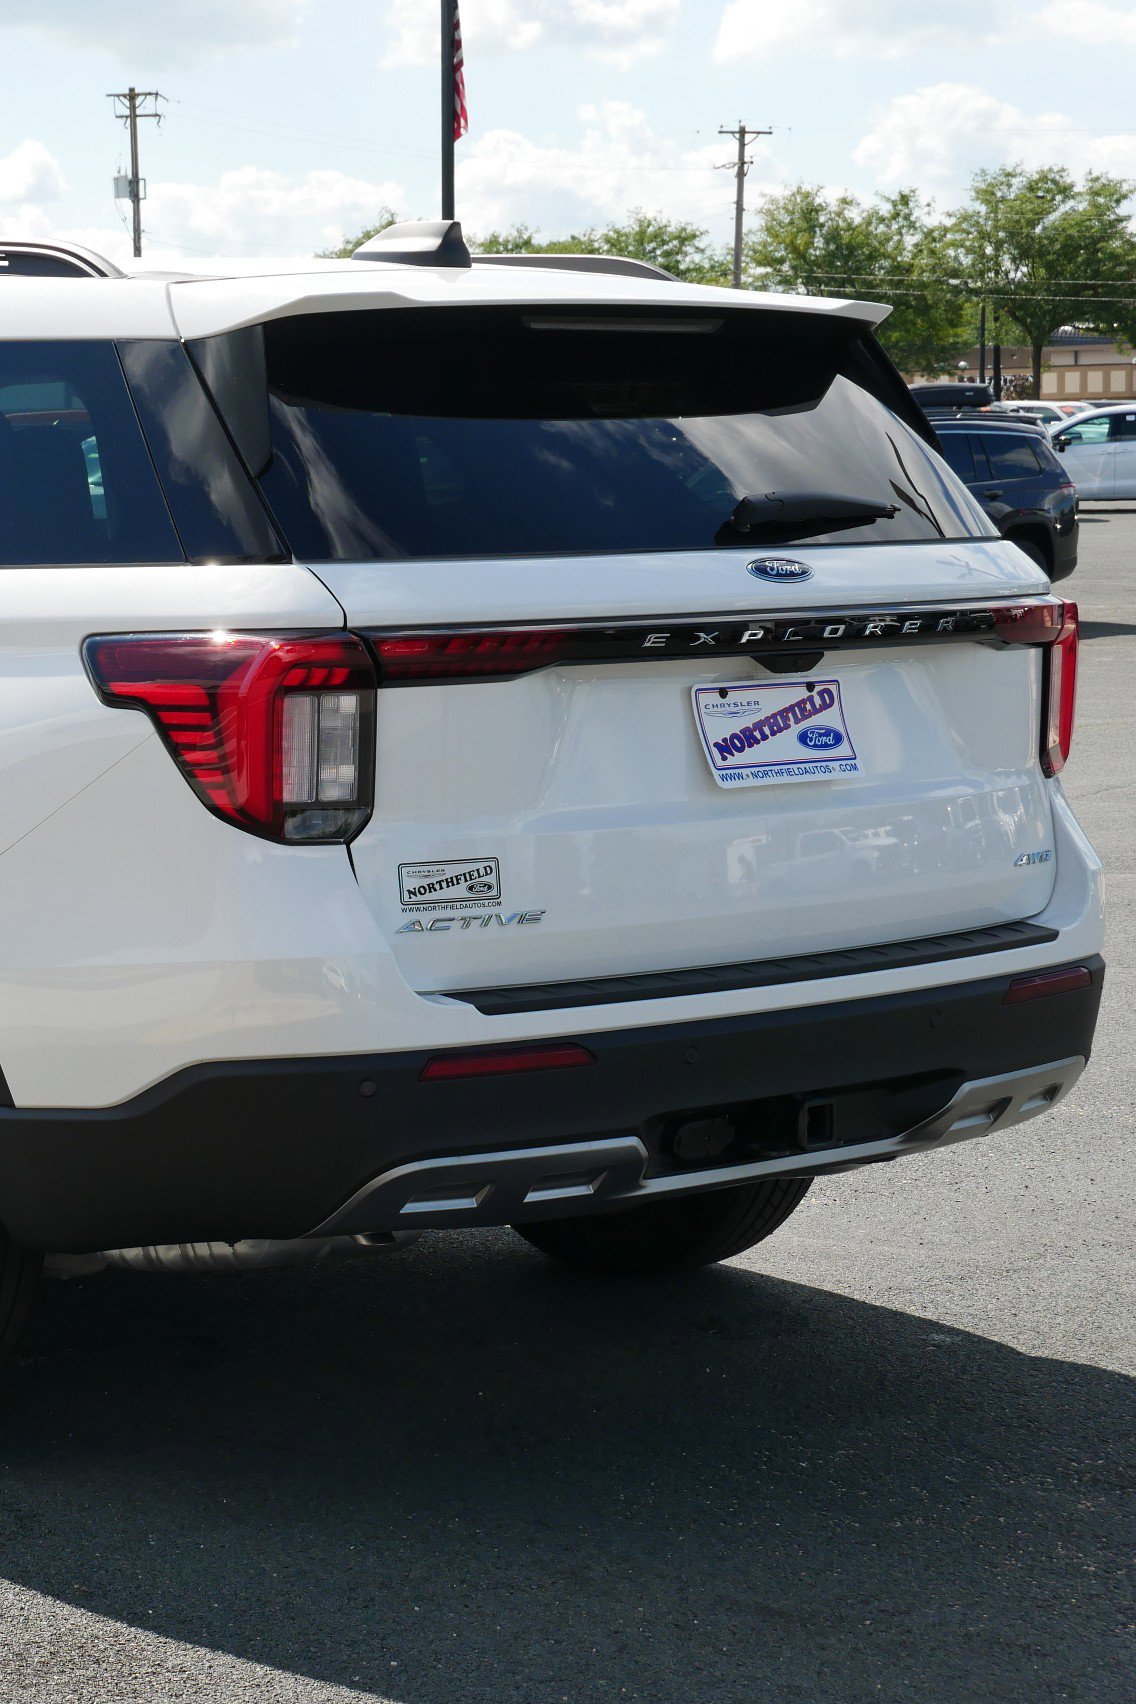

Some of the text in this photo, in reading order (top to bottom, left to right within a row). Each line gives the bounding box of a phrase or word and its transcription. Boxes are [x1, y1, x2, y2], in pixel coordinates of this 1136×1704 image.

[766, 561, 802, 575] Ford
[641, 617, 956, 648] EXPLORER
[704, 700, 760, 710] CHRYSLER
[713, 687, 835, 761] NORTHFIELD
[807, 729, 835, 746] Ford
[406, 864, 494, 900] NORTHFIELD
[401, 901, 502, 913] WWW.NORTHFIELDAUTOS.COM
[395, 909, 546, 934] ACTIVE
